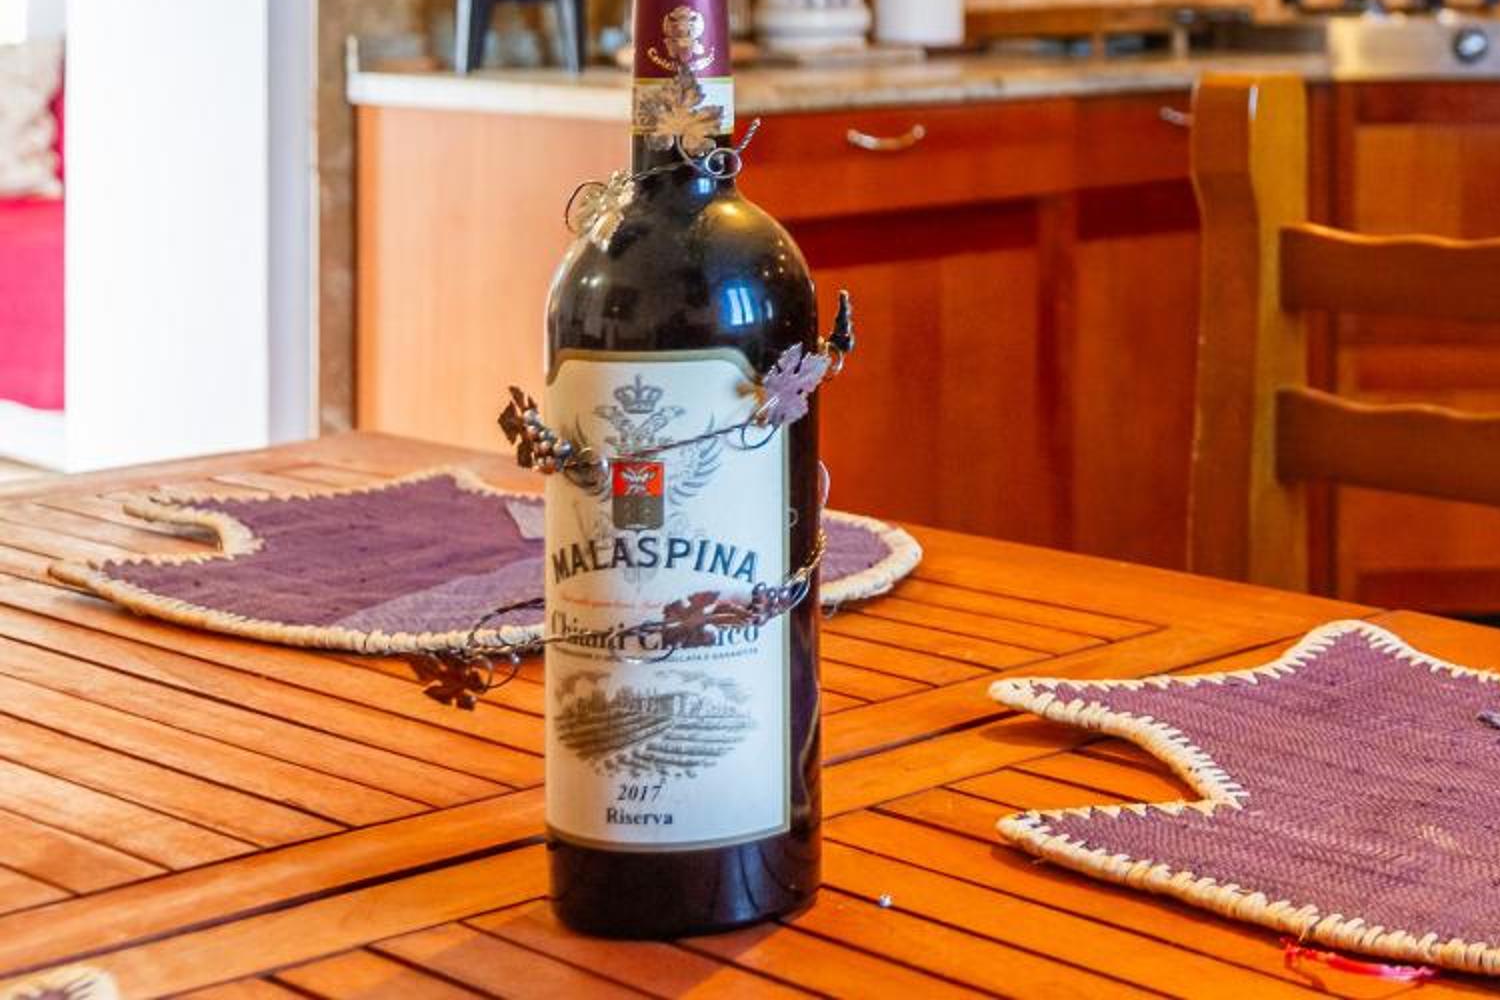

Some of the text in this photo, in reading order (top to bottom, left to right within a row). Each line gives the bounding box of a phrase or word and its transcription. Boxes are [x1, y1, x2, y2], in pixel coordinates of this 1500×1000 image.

[552, 537, 758, 584] MALASPINA
[617, 783, 662, 802] 2017
[606, 807, 673, 825] Riserva
